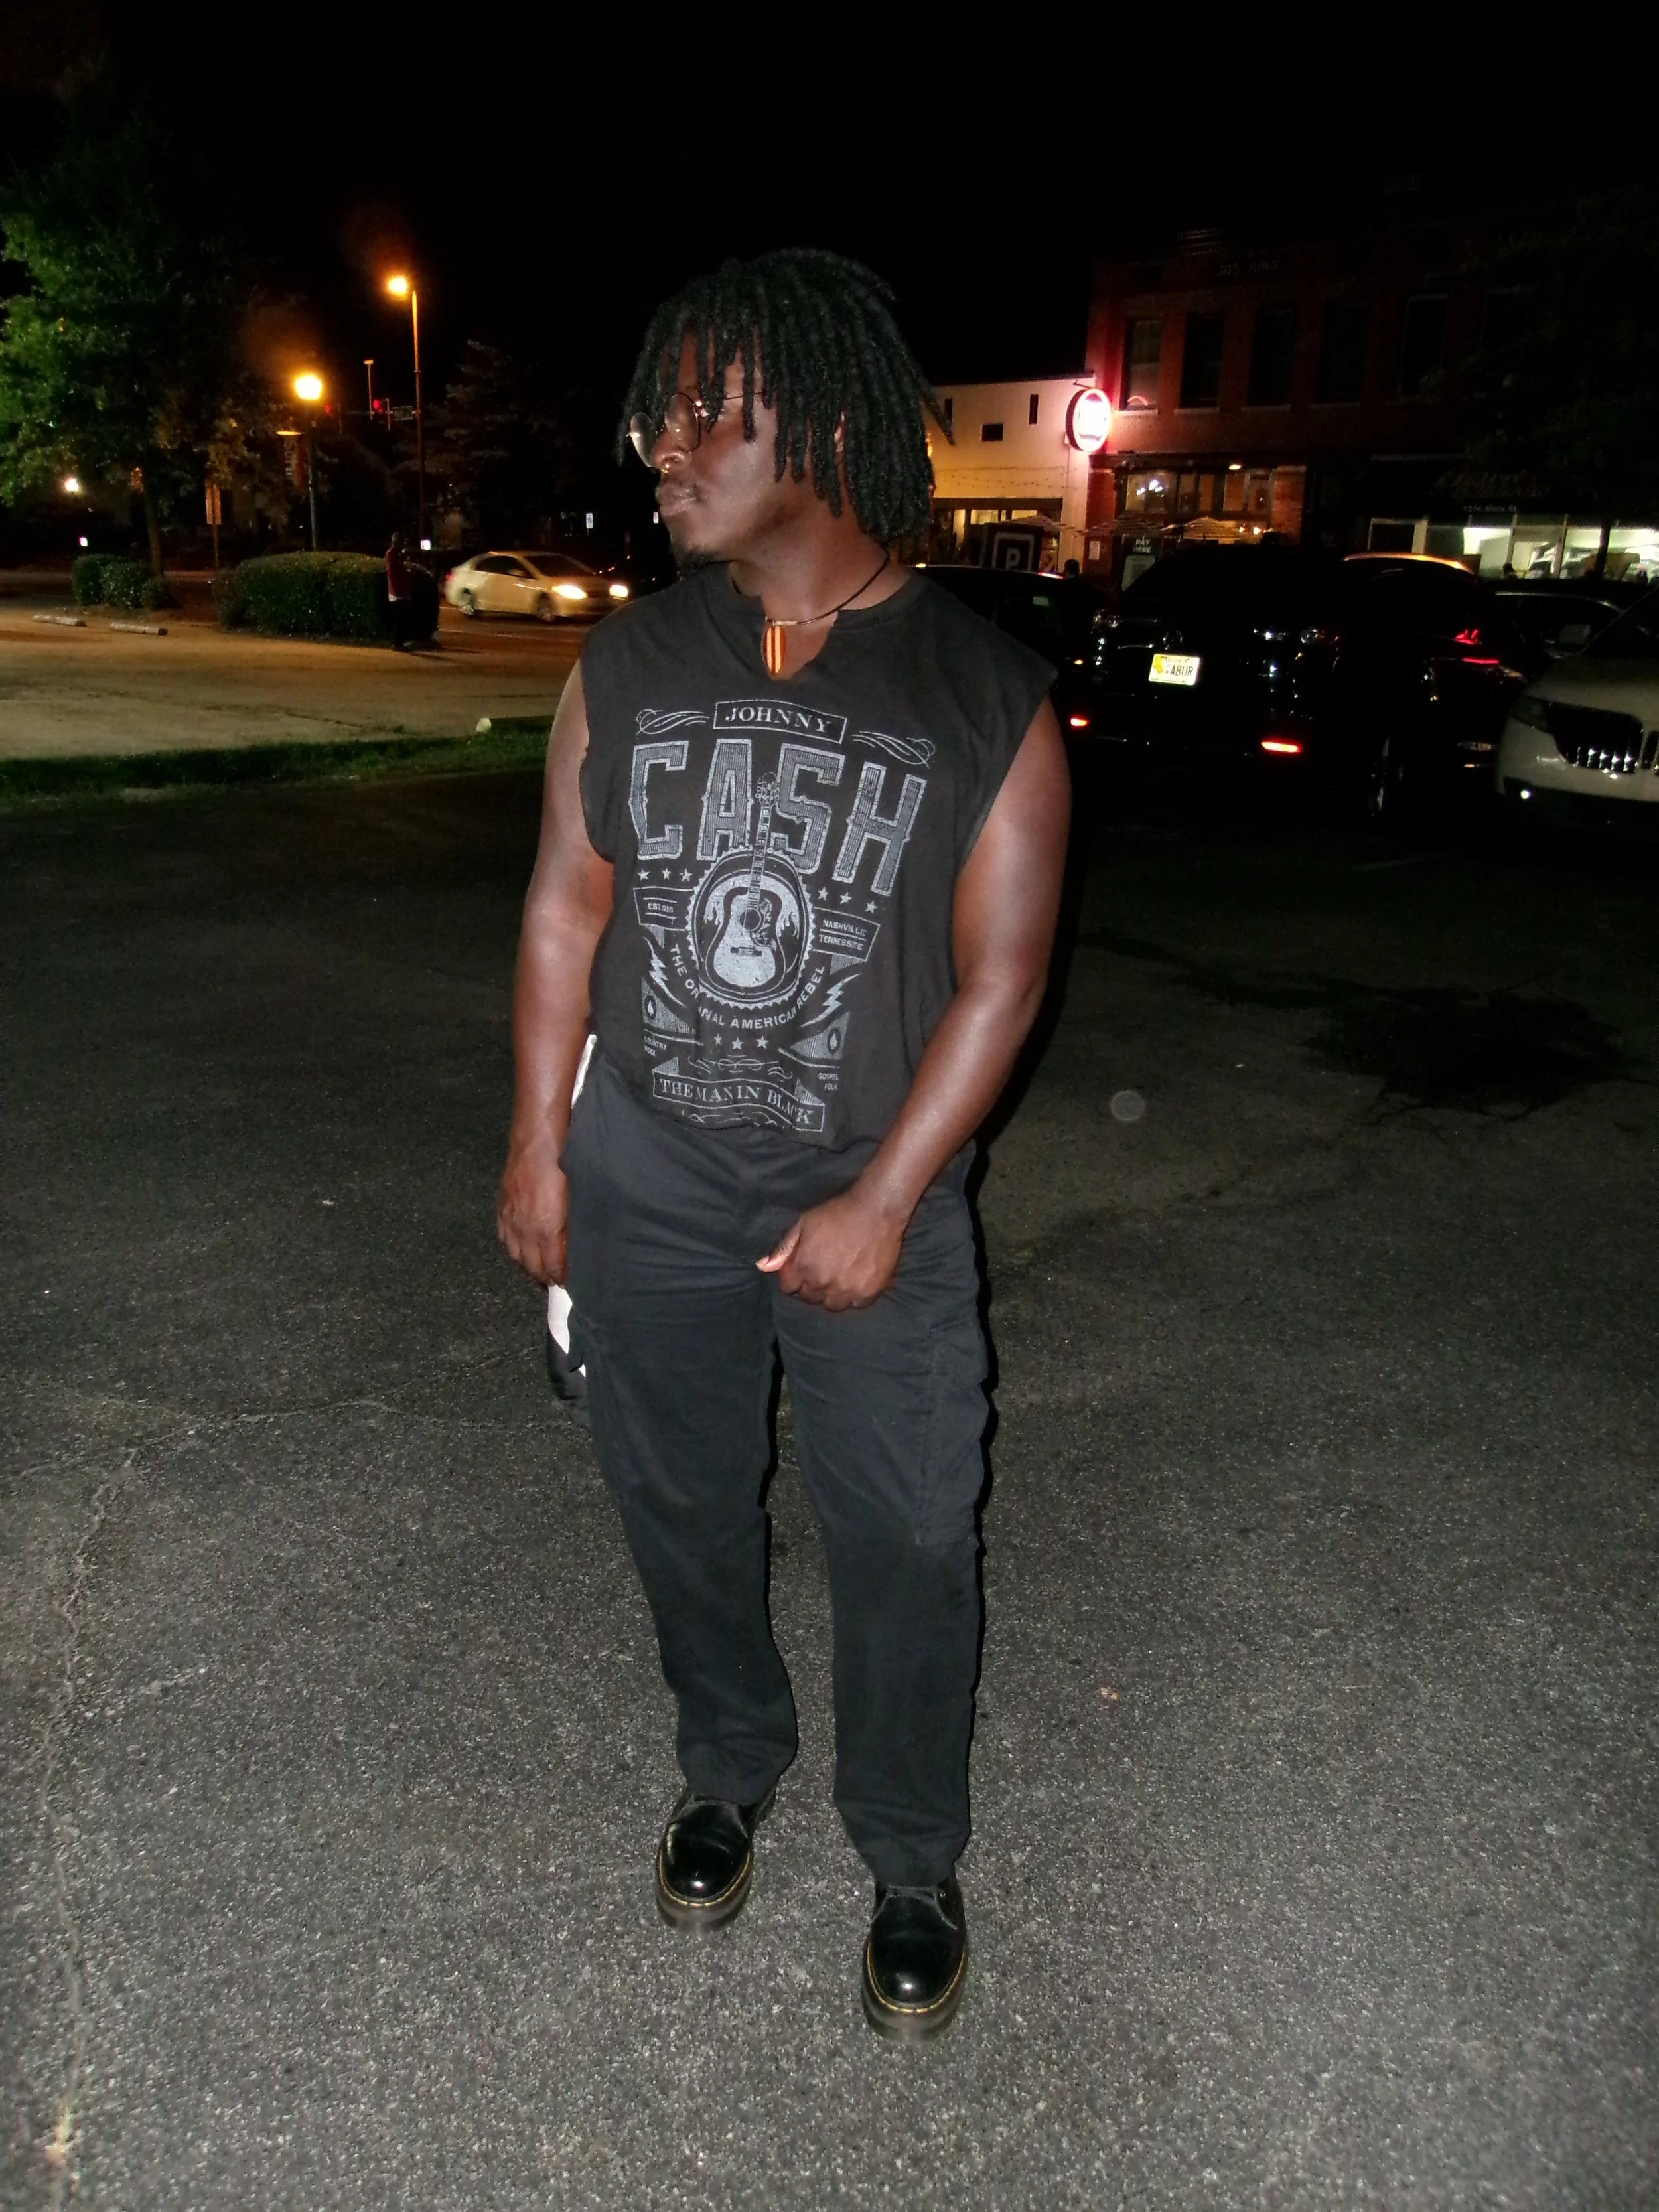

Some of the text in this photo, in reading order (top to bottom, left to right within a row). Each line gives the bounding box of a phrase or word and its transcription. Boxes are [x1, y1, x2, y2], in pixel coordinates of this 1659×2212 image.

[1135, 536, 1151, 546] PAY
[1004, 547, 1021, 570] P
[1170, 664, 1193, 676] ABUR
[725, 707, 833, 733] JOHNNY
[628, 739, 927, 896] CASH
[822, 919, 867, 936] NASHVILLE
[819, 934, 864, 951] TENNESSEE
[670, 944, 687, 977] THE
[730, 1005, 797, 1029] AMERICAN
[796, 966, 826, 1010] REBEL
[818, 1072, 839, 1080] GOSPEL
[660, 1078, 693, 1097] THE
[736, 1084, 762, 1099] IN
